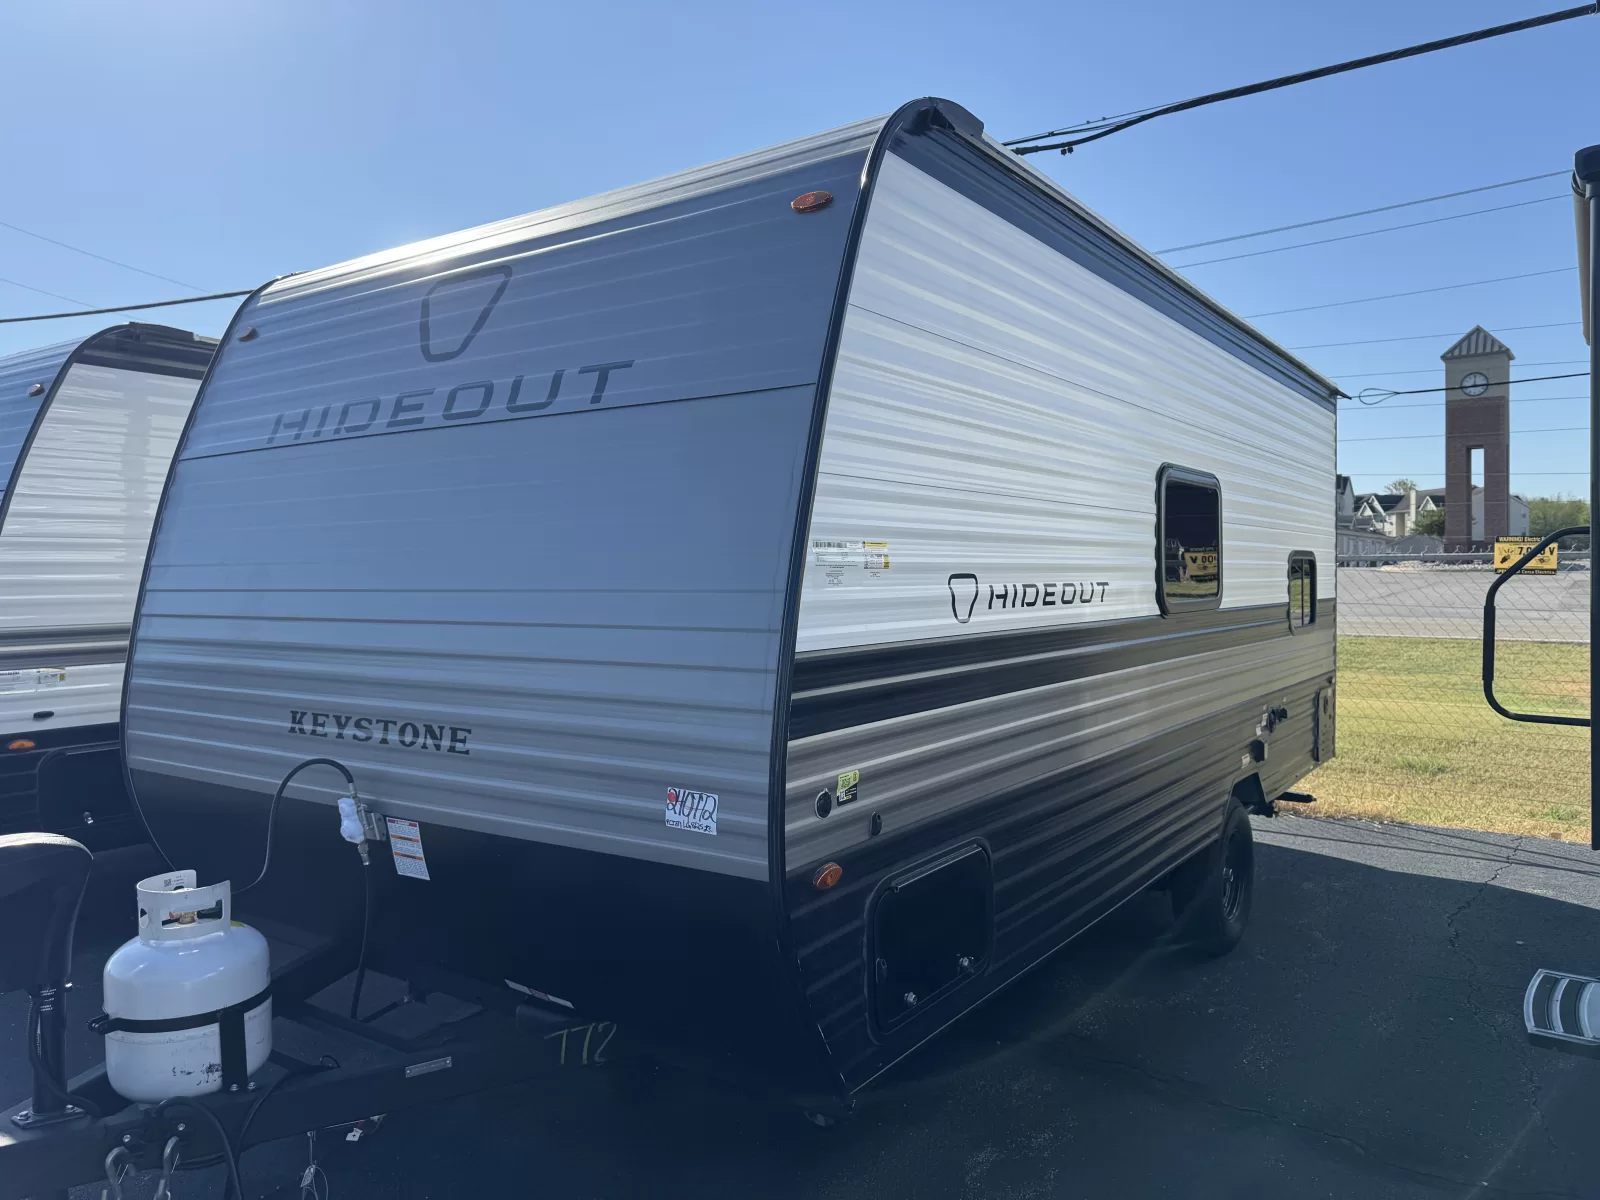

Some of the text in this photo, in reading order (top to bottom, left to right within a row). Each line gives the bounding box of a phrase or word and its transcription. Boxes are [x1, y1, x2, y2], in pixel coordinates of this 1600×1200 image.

[266, 359, 635, 445] HIDEOUT
[987, 581, 1110, 610] HIDEOUT
[287, 709, 473, 755] KEYSTONE
